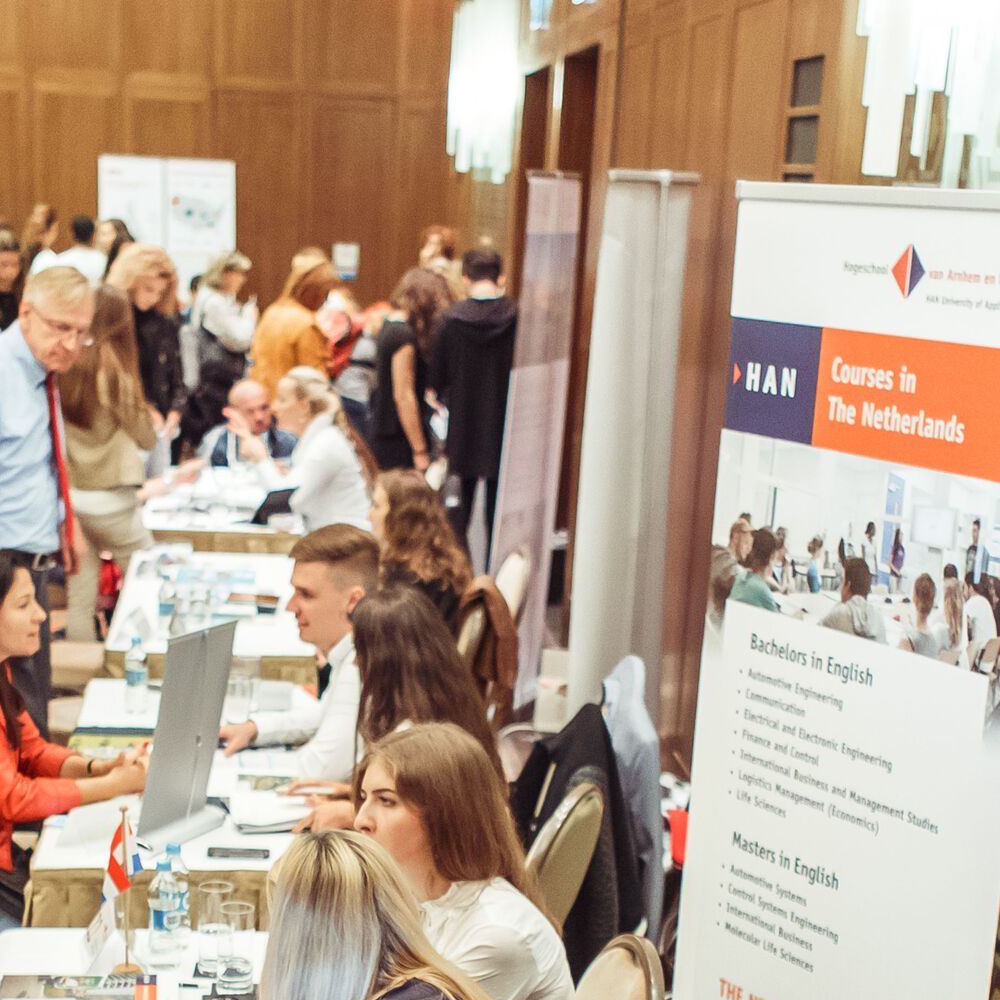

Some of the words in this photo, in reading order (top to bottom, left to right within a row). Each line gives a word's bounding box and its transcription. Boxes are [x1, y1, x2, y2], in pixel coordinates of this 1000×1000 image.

[947, 269, 981, 283] Arnhem
[984, 275, 995, 285] en
[745, 361, 798, 398] HAN
[830, 356, 894, 391] Courses
[899, 365, 917, 394] in
[828, 396, 856, 425] The
[861, 401, 965, 444] Netherlands
[750, 632, 807, 666] Bachelors
[810, 650, 823, 671] in
[827, 656, 873, 687] English
[745, 688, 806, 718] Communication
[747, 668, 792, 691] Automotive
[794, 682, 843, 712] Engineering
[742, 729, 771, 748] Finance
[774, 742, 788, 756] and
[790, 746, 819, 766] Control
[743, 708, 780, 731] Electrical
[782, 723, 796, 737] and
[798, 727, 838, 752] Electronic
[841, 742, 893, 774] Engineering
[736, 789, 751, 803] Life
[753, 795, 787, 819] Sciences
[738, 769, 772, 792] Logistics
[775, 783, 825, 812] Management
[827, 803, 880, 836] (Economics)
[740, 749, 791, 777] International
[793, 768, 829, 793] Business
[831, 784, 847, 799] and
[849, 790, 905, 822] Management
[907, 811, 939, 835] Studies
[732, 831, 776, 864] Masters
[779, 850, 790, 870] in
[794, 857, 839, 891] English
[730, 864, 773, 892] Automotive
[775, 883, 807, 908] Systems
[726, 902, 776, 935] International
[778, 926, 813, 952] Business
[728, 882, 756, 904] Control
[758, 895, 788, 920] Systems
[790, 911, 839, 945] Engineering
[725, 921, 761, 946] Molecular
[763, 939, 778, 956] Life
[780, 948, 814, 973] Sciences
